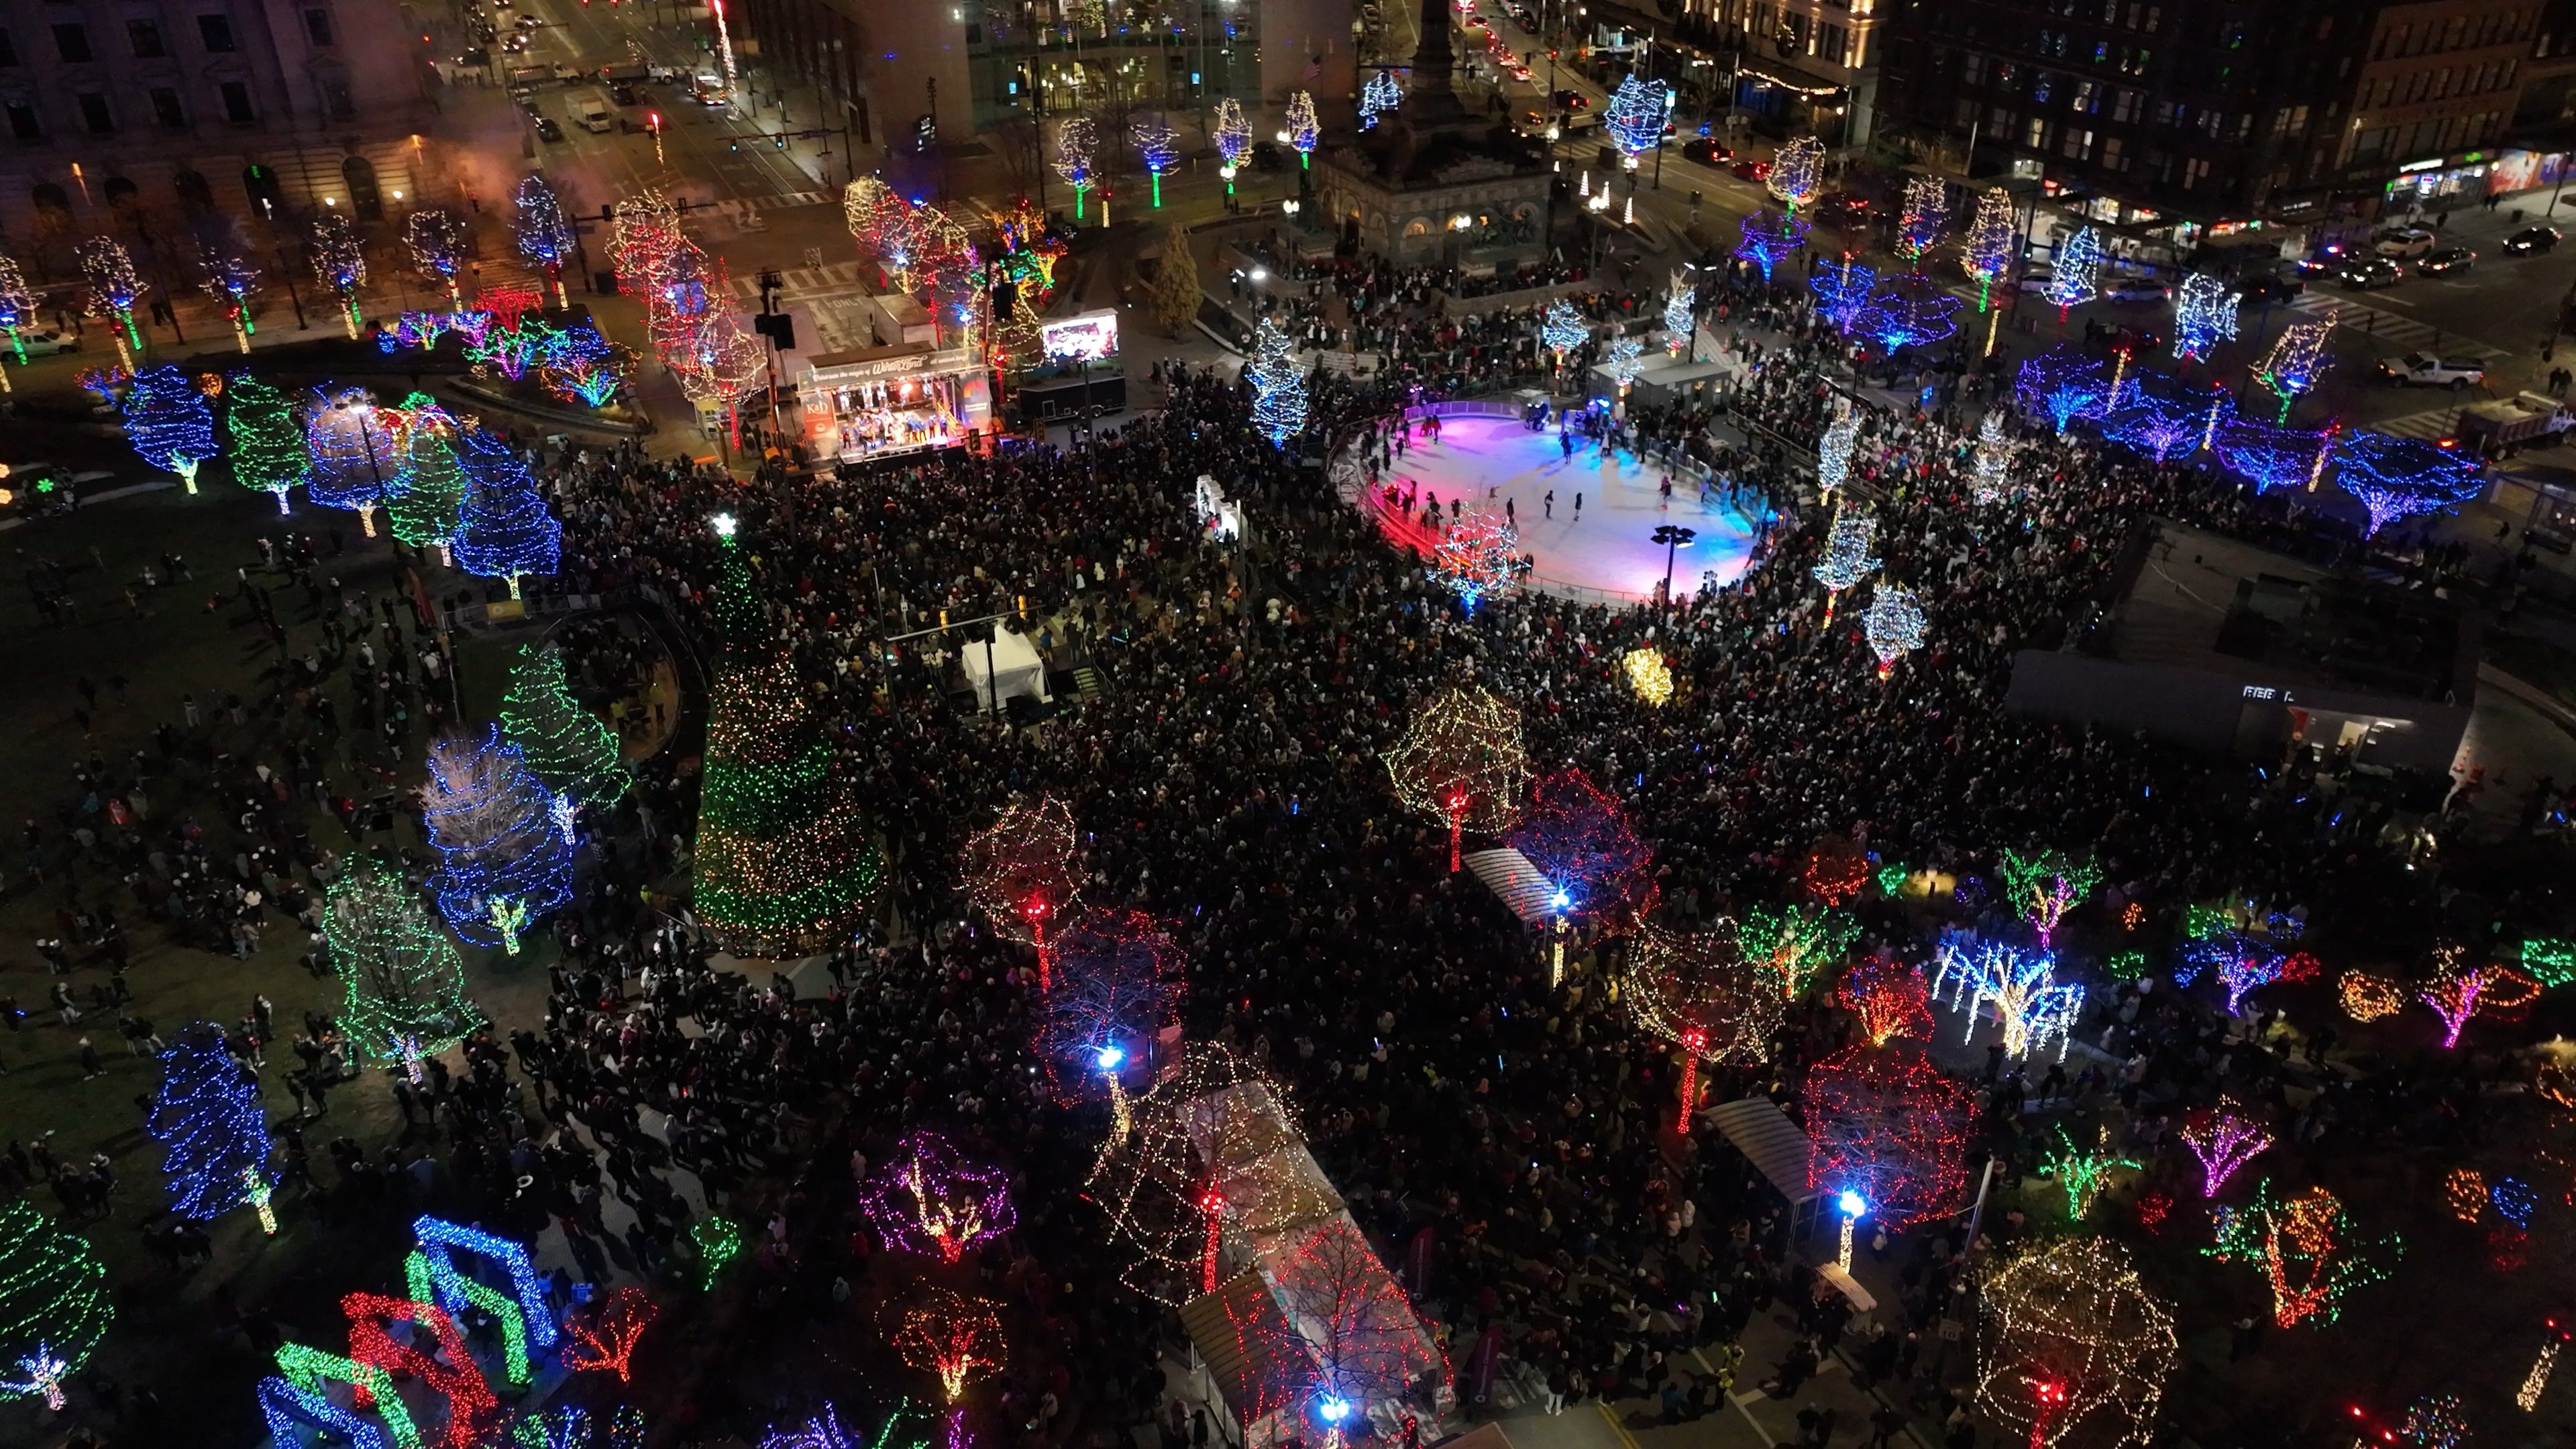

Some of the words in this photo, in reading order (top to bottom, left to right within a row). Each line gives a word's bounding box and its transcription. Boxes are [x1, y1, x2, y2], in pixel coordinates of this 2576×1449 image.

[833, 299, 863, 308] ONLY
[873, 355, 928, 375] WinterLand
[2243, 686, 2294, 702] REBL
